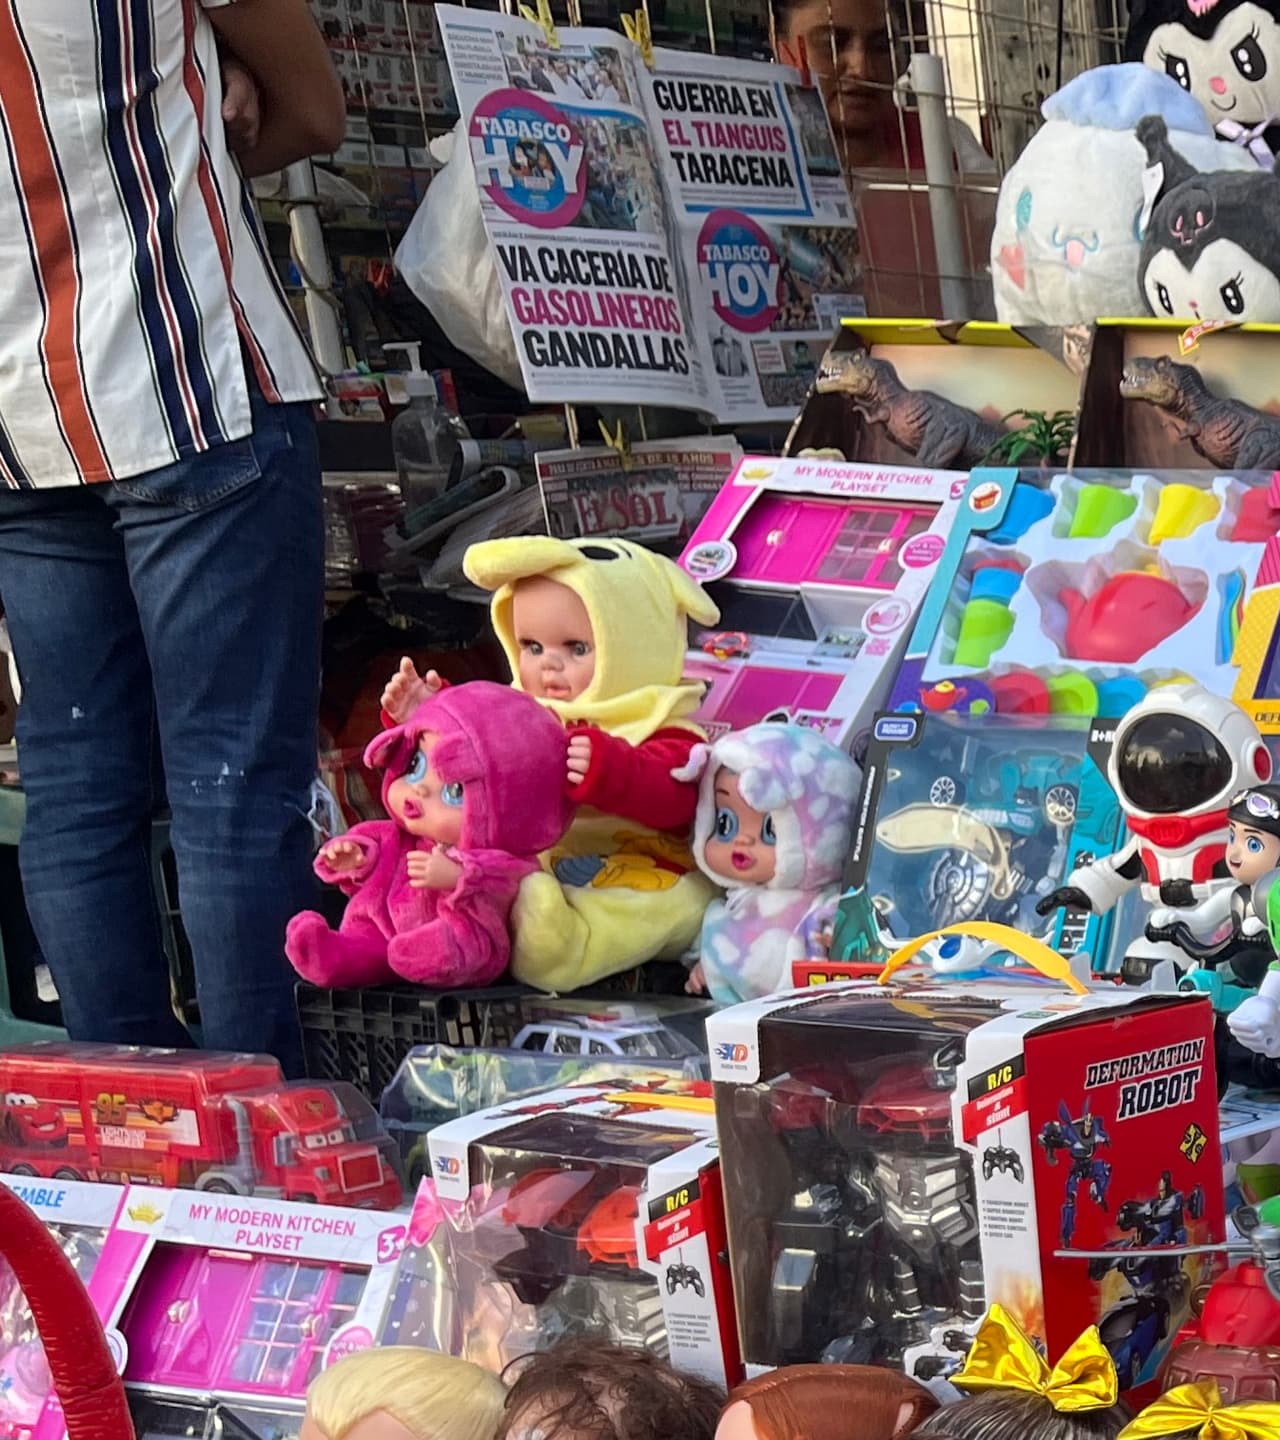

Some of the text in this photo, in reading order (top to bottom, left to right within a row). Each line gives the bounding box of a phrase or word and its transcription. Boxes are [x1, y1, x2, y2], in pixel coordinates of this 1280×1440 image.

[653, 80, 778, 119] GUERRA EN
[475, 117, 571, 142] TABASCO
[662, 119, 786, 152] EL TIANGUIS
[470, 136, 585, 193] HY
[670, 152, 795, 188] TARACENA
[496, 245, 674, 293] VA CACERÍA DE
[702, 244, 770, 261] TABASCO
[700, 262, 780, 307] HOY
[511, 287, 682, 335] GASOLINEROS
[522, 330, 689, 376] GANDALLAS
[794, 466, 934, 485] MY MODERN KITCHEN
[831, 481, 889, 493] PLAYSET
[987, 1066, 1014, 1090] R/C
[1084, 1039, 1204, 1089] DEFORMATION
[1117, 1068, 1200, 1122] ROBOT
[664, 1187, 690, 1213] R/C
[190, 1205, 355, 1235] MY MODERN KITCHEN
[235, 1232, 303, 1251] PLAYSET
